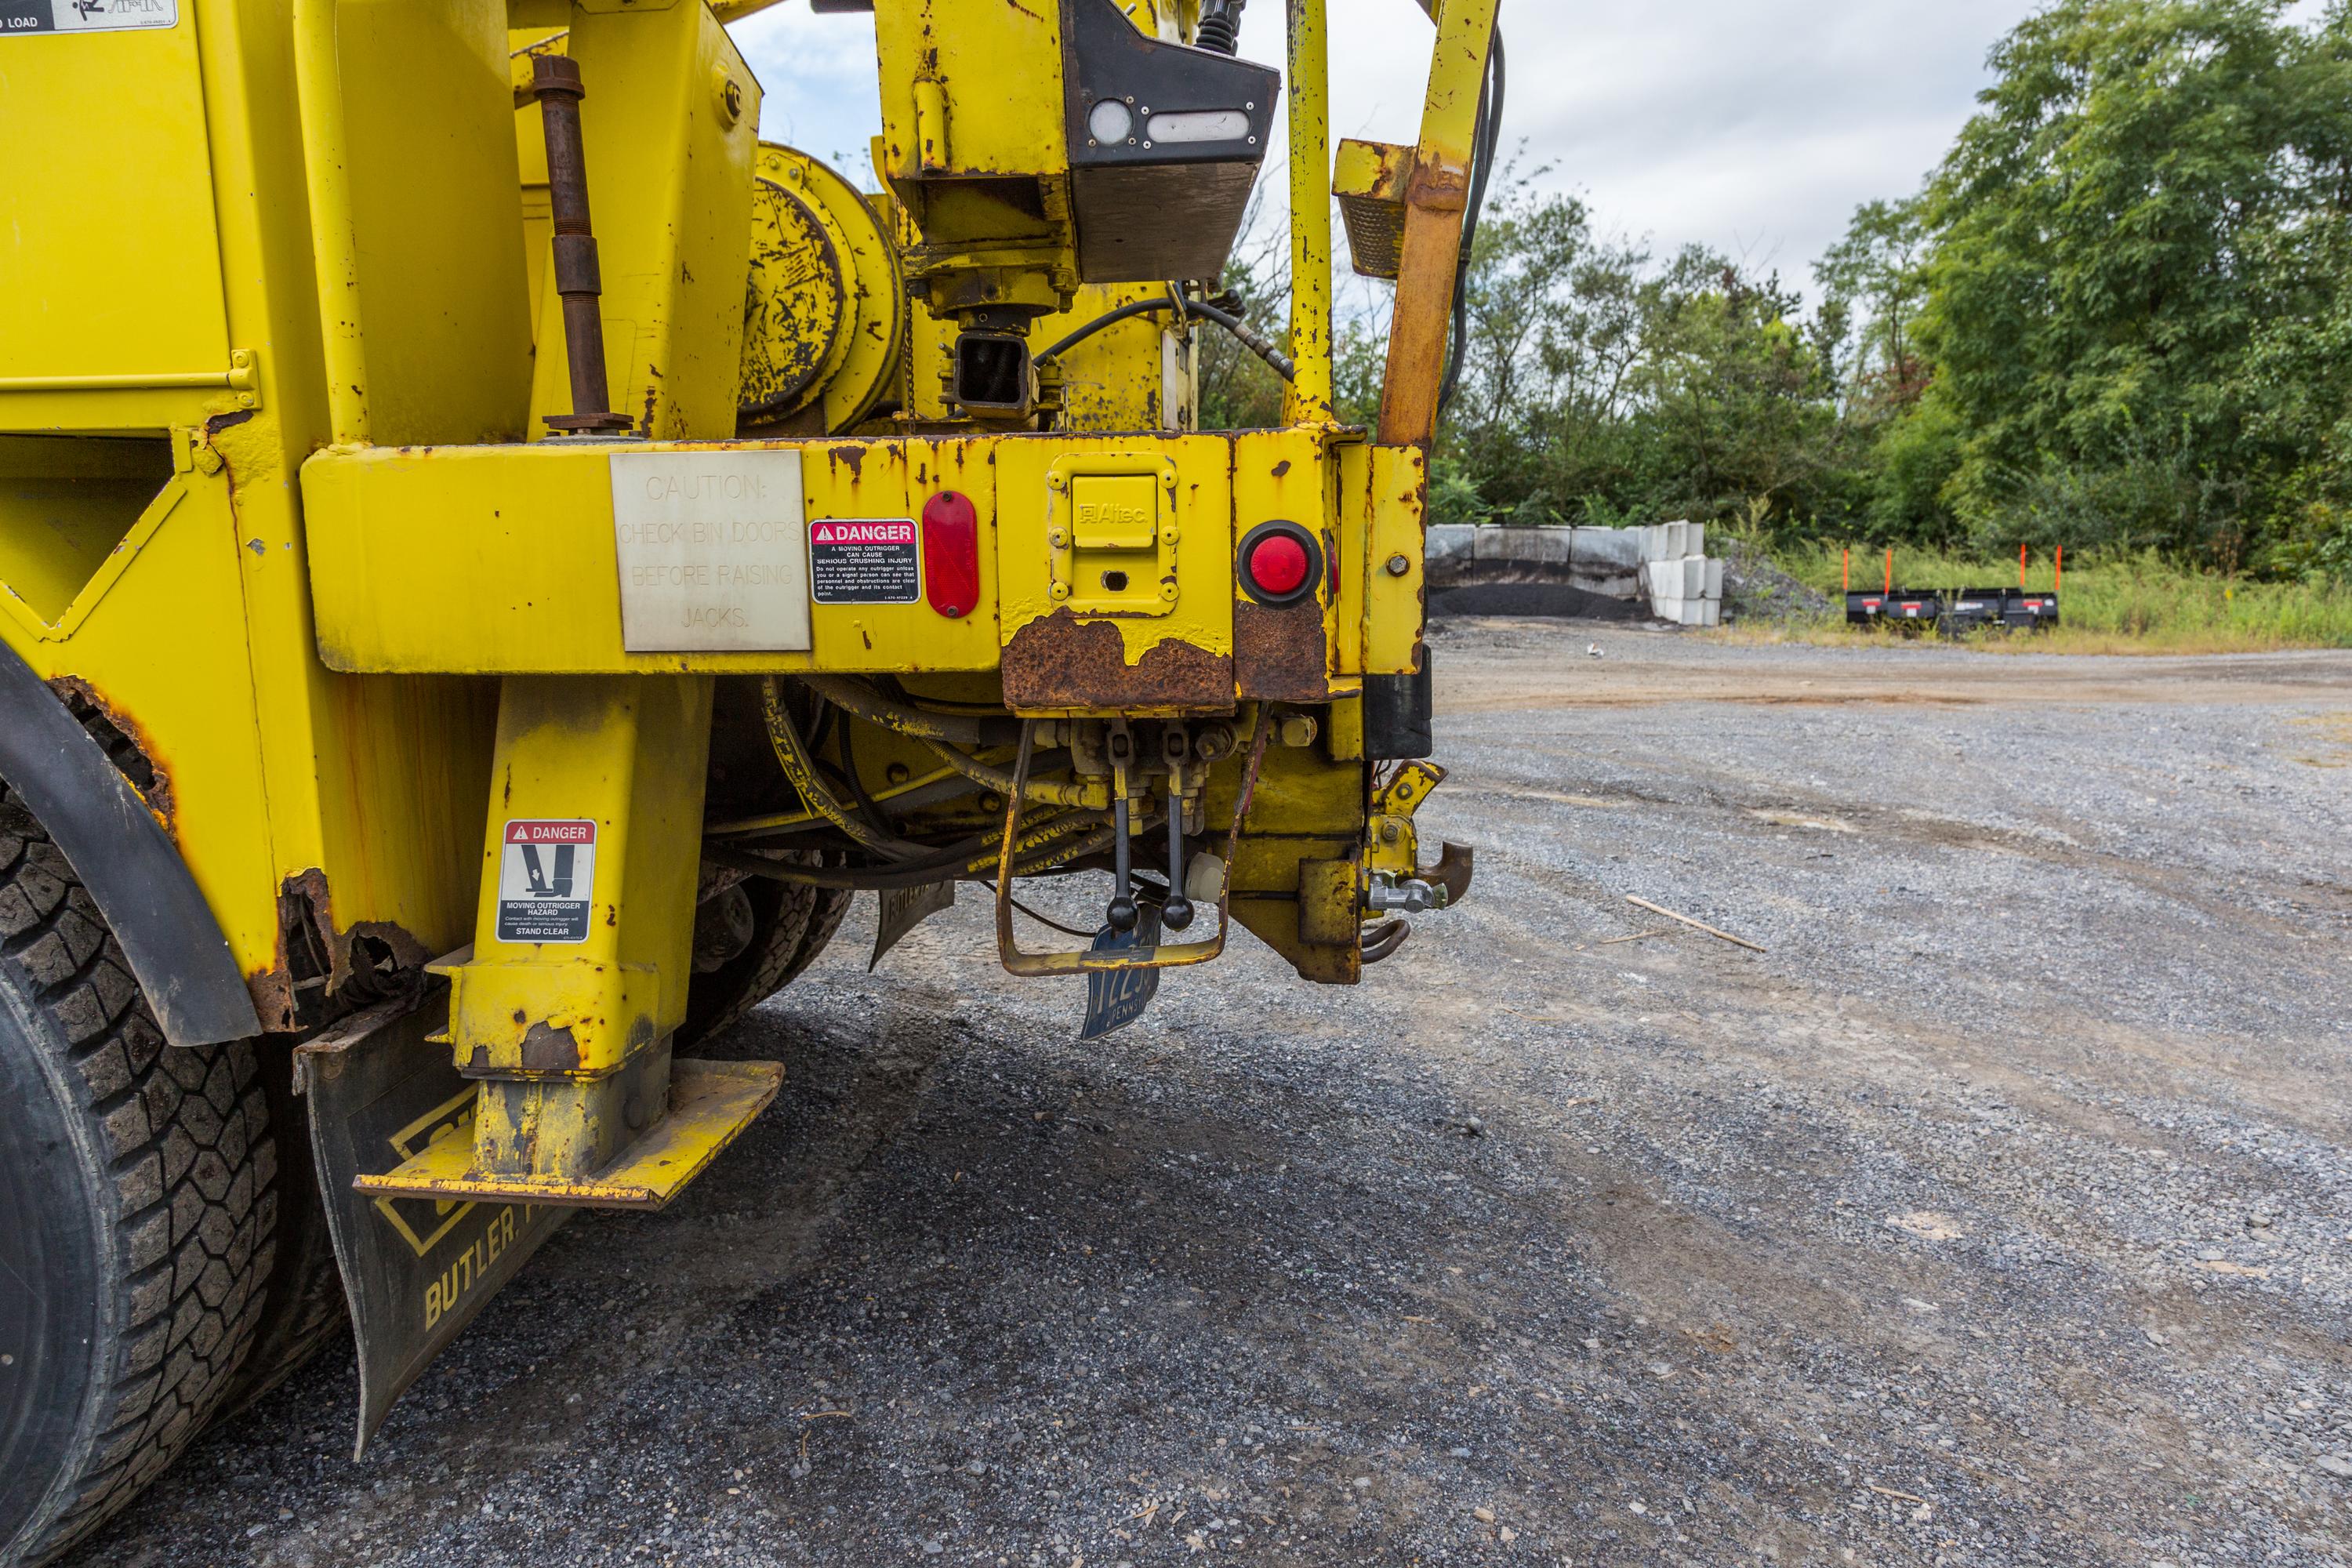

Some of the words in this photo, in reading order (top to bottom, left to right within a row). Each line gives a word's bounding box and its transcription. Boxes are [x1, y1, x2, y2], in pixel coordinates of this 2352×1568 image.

[8, 17, 38, 28] LOAD
[646, 474, 767, 500] CAUTION:
[619, 522, 685, 545] CHECK
[692, 522, 723, 543] BIN
[732, 521, 801, 543] DOORS
[836, 526, 911, 540] DANGER
[632, 566, 709, 586] BEFORE
[717, 564, 792, 586] RAISING
[681, 608, 749, 628] JACKS.
[533, 826, 586, 839] DANGER
[425, 1205, 519, 1333] BUTLER,
